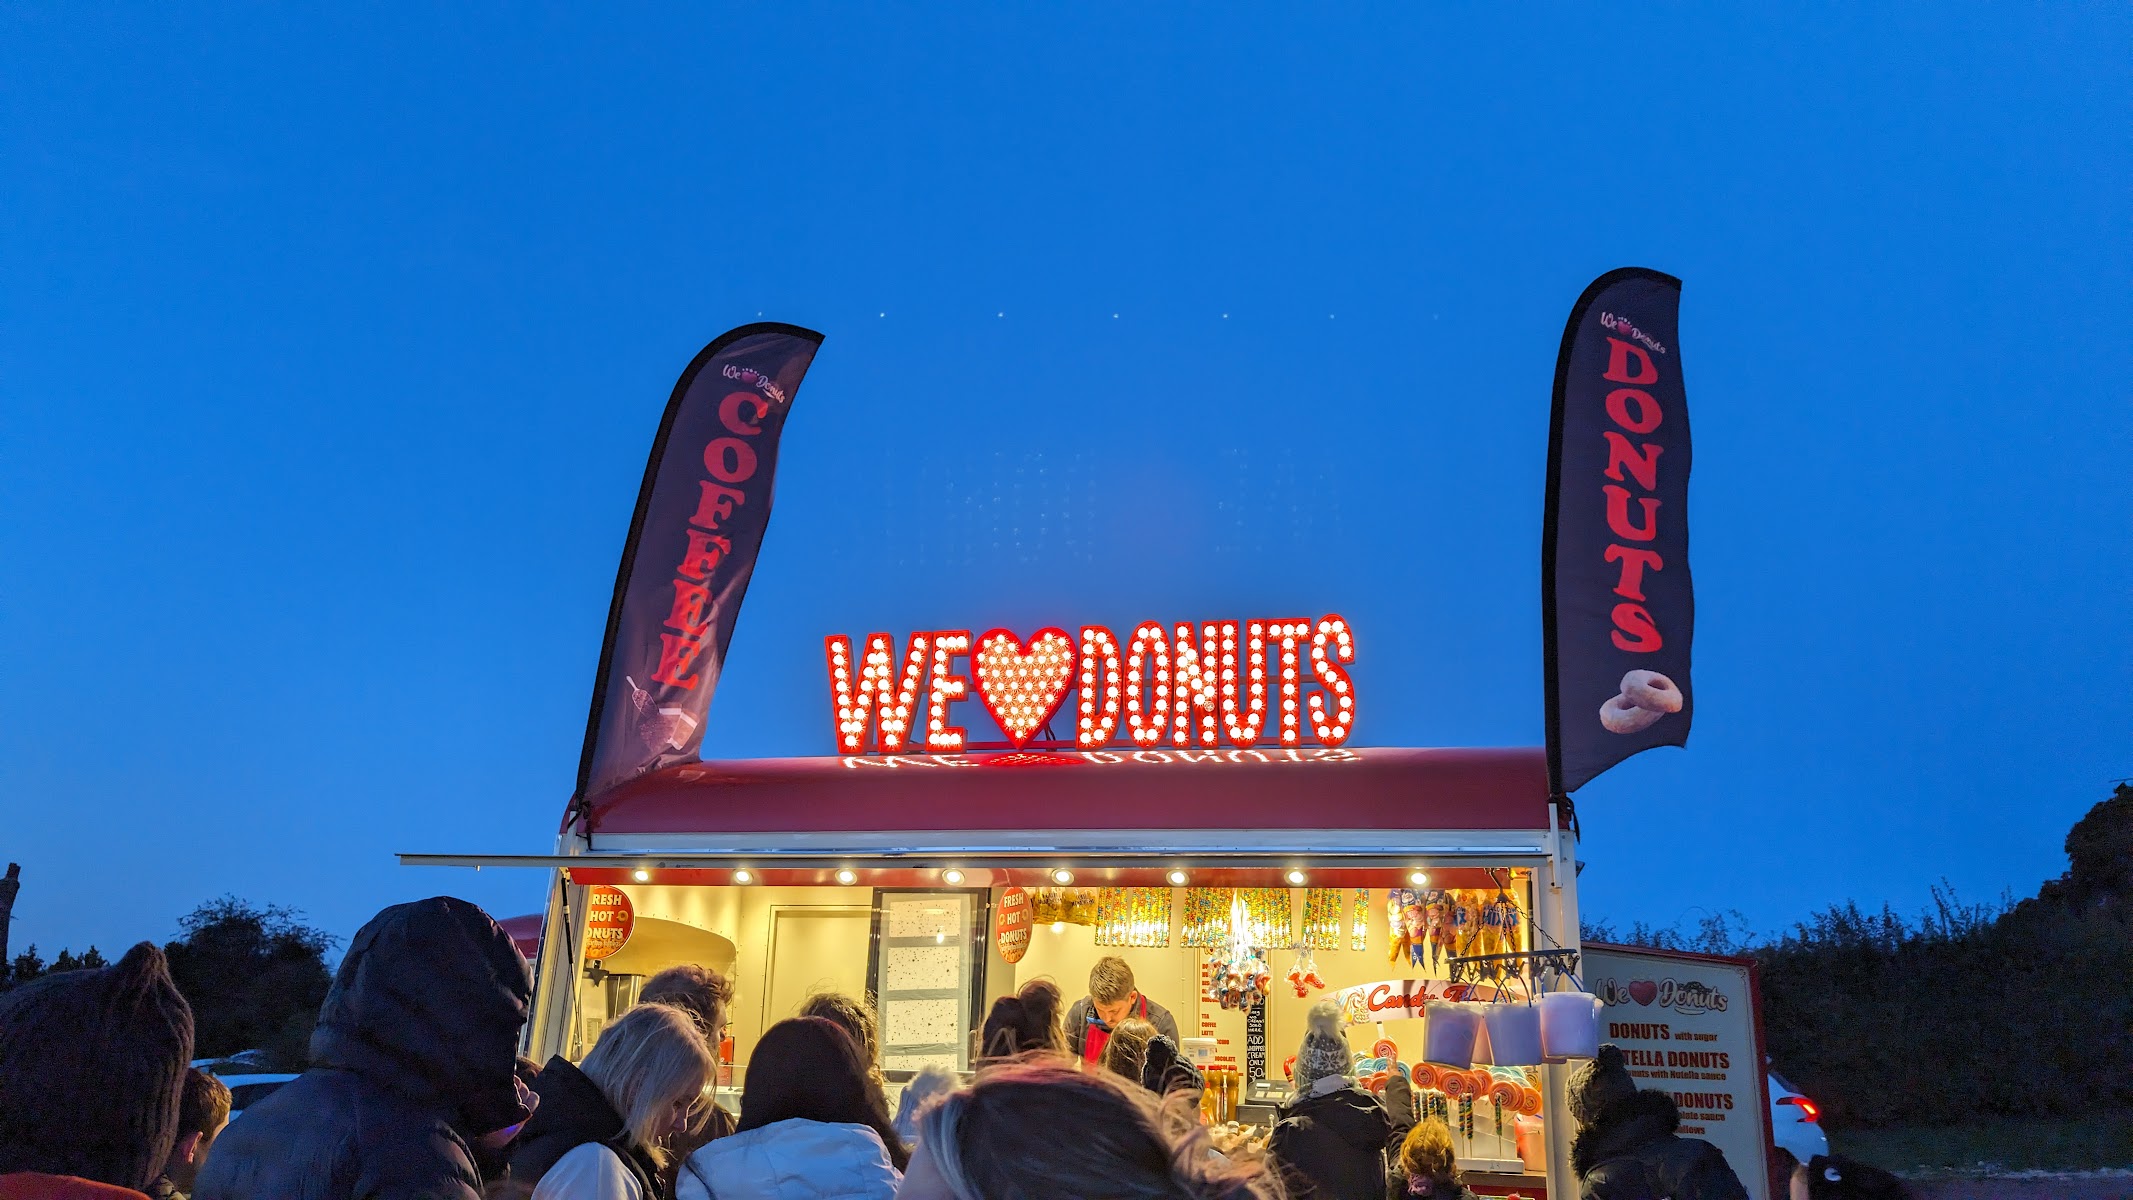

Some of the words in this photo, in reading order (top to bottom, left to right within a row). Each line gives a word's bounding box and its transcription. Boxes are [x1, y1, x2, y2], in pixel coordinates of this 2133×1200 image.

[1600, 311, 1618, 330] We
[1631, 327, 1666, 354] Donuts
[722, 364, 741, 380] We
[756, 375, 785, 403] Donuts
[1603, 336, 1663, 653] DONUTS
[650, 391, 768, 690] COFFEE
[824, 630, 972, 754] WE
[1076, 613, 1357, 750] DONUTS
[592, 893, 622, 905] RESH
[1003, 893, 1024, 908] FRESH
[589, 910, 614, 922] HOT
[1006, 911, 1020, 925] HOT
[587, 927, 624, 939] ONUTS
[1001, 928, 1027, 943] DONUTS
[1595, 978, 1630, 1006] We
[1659, 978, 1729, 1012] Donuts
[1609, 1022, 1670, 1040] DONUTS
[1675, 1031, 1693, 1041] with
[1694, 1033, 1718, 1042] sugar
[1247, 1035, 1264, 1045] ADD
[1249, 1059, 1265, 1067] ONLY
[1622, 1049, 1665, 1067] TELLA
[1667, 1051, 1730, 1069] DONUTS
[1631, 1069, 1650, 1078] nuts
[1650, 1069, 1669, 1079] with
[1670, 1069, 1699, 1080] Nutella
[1701, 1072, 1727, 1081] sauce
[1674, 1092, 1734, 1110] DONUTS
[1700, 1112, 1726, 1122] sauce
